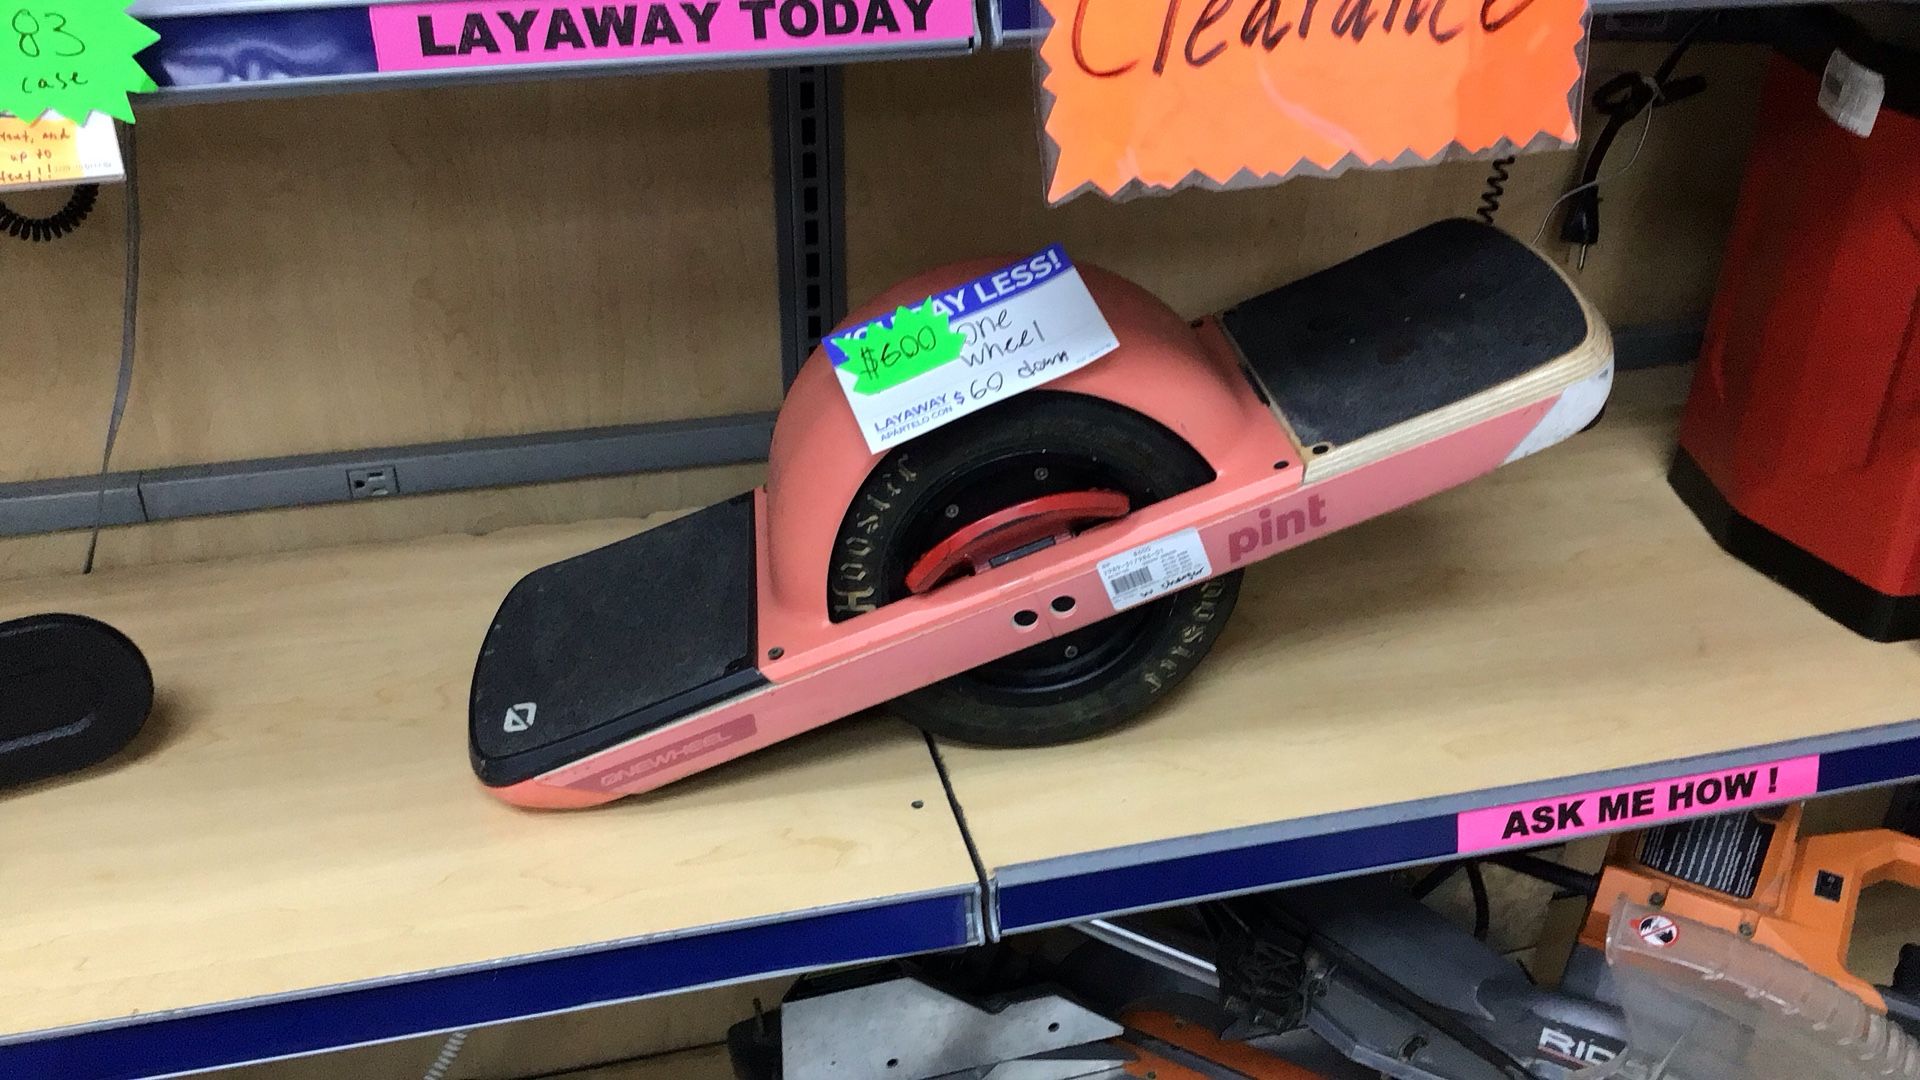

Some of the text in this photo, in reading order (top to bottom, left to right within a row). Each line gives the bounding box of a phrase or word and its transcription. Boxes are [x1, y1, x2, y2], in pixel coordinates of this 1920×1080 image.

[12, 9, 85, 58] 83
[417, 0, 933, 57] LAYAWAY TODAY
[22, 71, 88, 94] case
[10, 148, 52, 163] up to
[911, 248, 1063, 318] AY LESS!
[860, 324, 936, 382] $600
[960, 319, 1046, 367] wheel
[874, 392, 947, 433] LAYAWAY
[969, 370, 1004, 400] 60
[1228, 492, 1328, 564] pint
[600, 731, 733, 787] ONEWHEEL
[1501, 799, 1586, 840] ASK
[1597, 788, 1655, 823] ME
[1667, 771, 1758, 811] HOW
